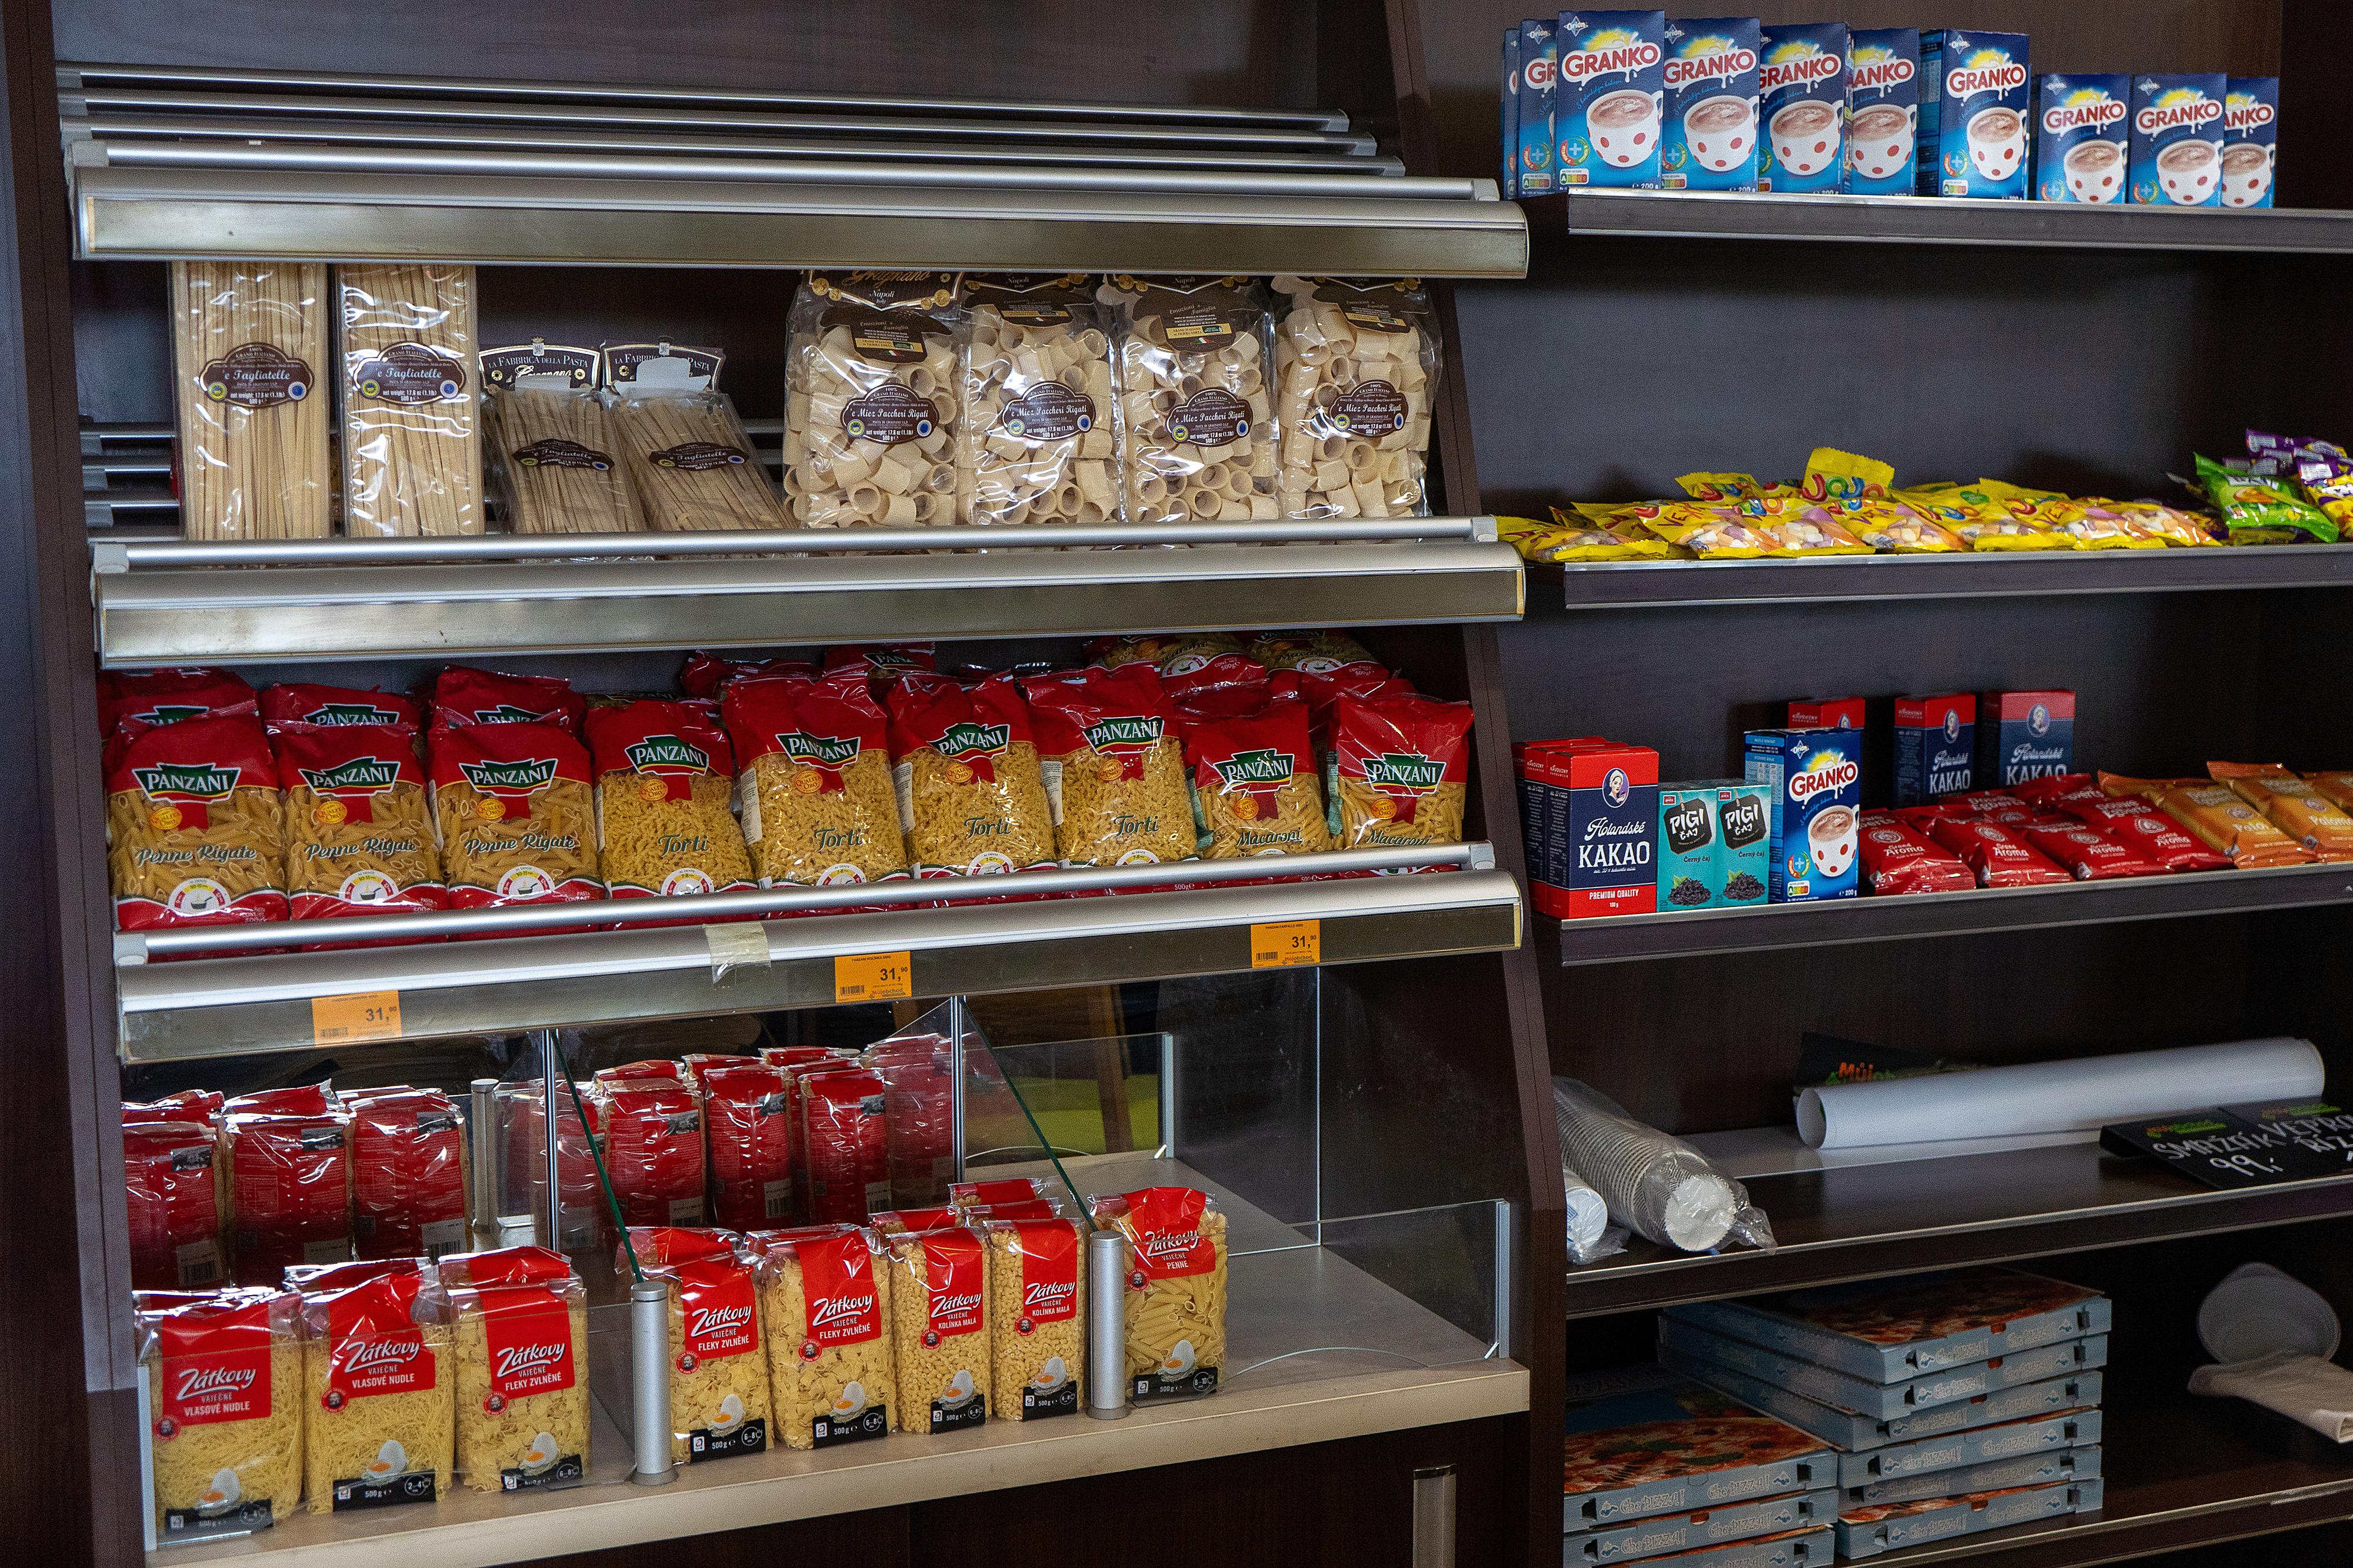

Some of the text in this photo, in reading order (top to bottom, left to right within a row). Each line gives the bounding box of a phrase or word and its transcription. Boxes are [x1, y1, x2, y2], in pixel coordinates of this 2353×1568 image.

[1565, 45, 1658, 77] GRANKO
[1664, 51, 1754, 84] GRANKO
[1949, 66, 2025, 92] GRANKO
[2045, 103, 2124, 129] GRANKO
[2139, 102, 2220, 130] GRANKO
[869, 289, 895, 298] Napoli
[498, 355, 540, 366] FABBRICA
[562, 356, 588, 368] PASTA
[233, 369, 290, 383] Tagliatelle
[386, 368, 441, 381] Tagliatelle
[858, 408, 875, 417] Miez
[878, 409, 906, 418] Paccheri
[908, 409, 928, 420] Rigati
[1017, 407, 1034, 416] Miez
[1036, 406, 1064, 416] Paccheri
[1066, 405, 1086, 415] Rigati
[1181, 414, 1198, 423] Miez
[1199, 412, 1226, 421] Paccheri
[1228, 411, 1245, 421] Rigati
[1344, 403, 1361, 412] Miez
[1362, 403, 1388, 412] Paccheri
[542, 449, 592, 459] Tagliatelle
[677, 451, 727, 461] Tagliatelle
[939, 730, 1004, 755] PANZANI
[1091, 720, 1159, 745] PANZANI
[636, 745, 705, 766] PANZANI
[788, 738, 854, 760] PANZANI
[148, 771, 230, 792] PANZANI
[314, 766, 391, 788] PANZANI
[472, 765, 549, 785] PANZANI
[954, 773, 968, 781] ORO
[1226, 759, 1290, 782] PANZANI
[1372, 763, 1437, 783] PANZANI
[1791, 763, 1857, 796] GRANKO
[1929, 769, 1971, 795] KAKAO
[964, 816, 1012, 839] Torti
[1114, 813, 1160, 836] Torti
[1669, 808, 1704, 835] PIGI
[1725, 803, 1759, 830] PIGI
[814, 827, 863, 852] Torti
[1237, 826, 1303, 848] Macaroni
[1584, 816, 1646, 841] Holandské
[1679, 828, 1698, 840] ČAJ
[1735, 823, 1753, 836] ČAJ
[304, 838, 418, 862] Penne Rigate
[464, 833, 576, 856] Penne Rigate
[658, 834, 711, 857] Torti
[1883, 845, 1926, 856] Aroma
[1993, 847, 2030, 858] Aroma
[2155, 836, 2191, 847] Aroma
[136, 843, 258, 868] Penne Rigate
[1578, 841, 1650, 869] KAKAO
[1589, 889, 1639, 900] PREMIUM QUALITY
[1145, 1228, 1200, 1257] Zátkovy
[1166, 1260, 1189, 1270] PENNE
[1025, 1280, 1075, 1305] Zátkovy
[1041, 1299, 1062, 1307] VAJEČNÉ
[812, 1294, 873, 1327] Zátkovy
[931, 1293, 982, 1318] Zátkovy
[947, 1310, 968, 1320] VAJEČNÉ
[1032, 1304, 1070, 1317] KOLÍNKA MALÁ
[691, 1305, 752, 1337] Zátkovy
[819, 1323, 872, 1340] FLEKY ZVLNĚNÉ
[832, 1316, 858, 1328] VAJEČNÉ
[938, 1316, 977, 1329] KOLÍNKA MALÁ
[698, 1336, 750, 1352] FLEKY ZVLNĚNÉ
[711, 1327, 737, 1339] VAJEČNÉ
[344, 1339, 421, 1374] Zátkovy
[496, 1342, 566, 1379] Zátkovy
[176, 1366, 256, 1402] Zátkovy
[352, 1373, 415, 1389] VLASOVÉ NUDLE
[505, 1372, 562, 1392] FLEKY ZVLNĚNÉ
[184, 1401, 251, 1417] VLASOVÉ NUDLE
[1642, 1489, 1685, 1511] PIZZA!
[1643, 1529, 1687, 1551] PIZZA!
